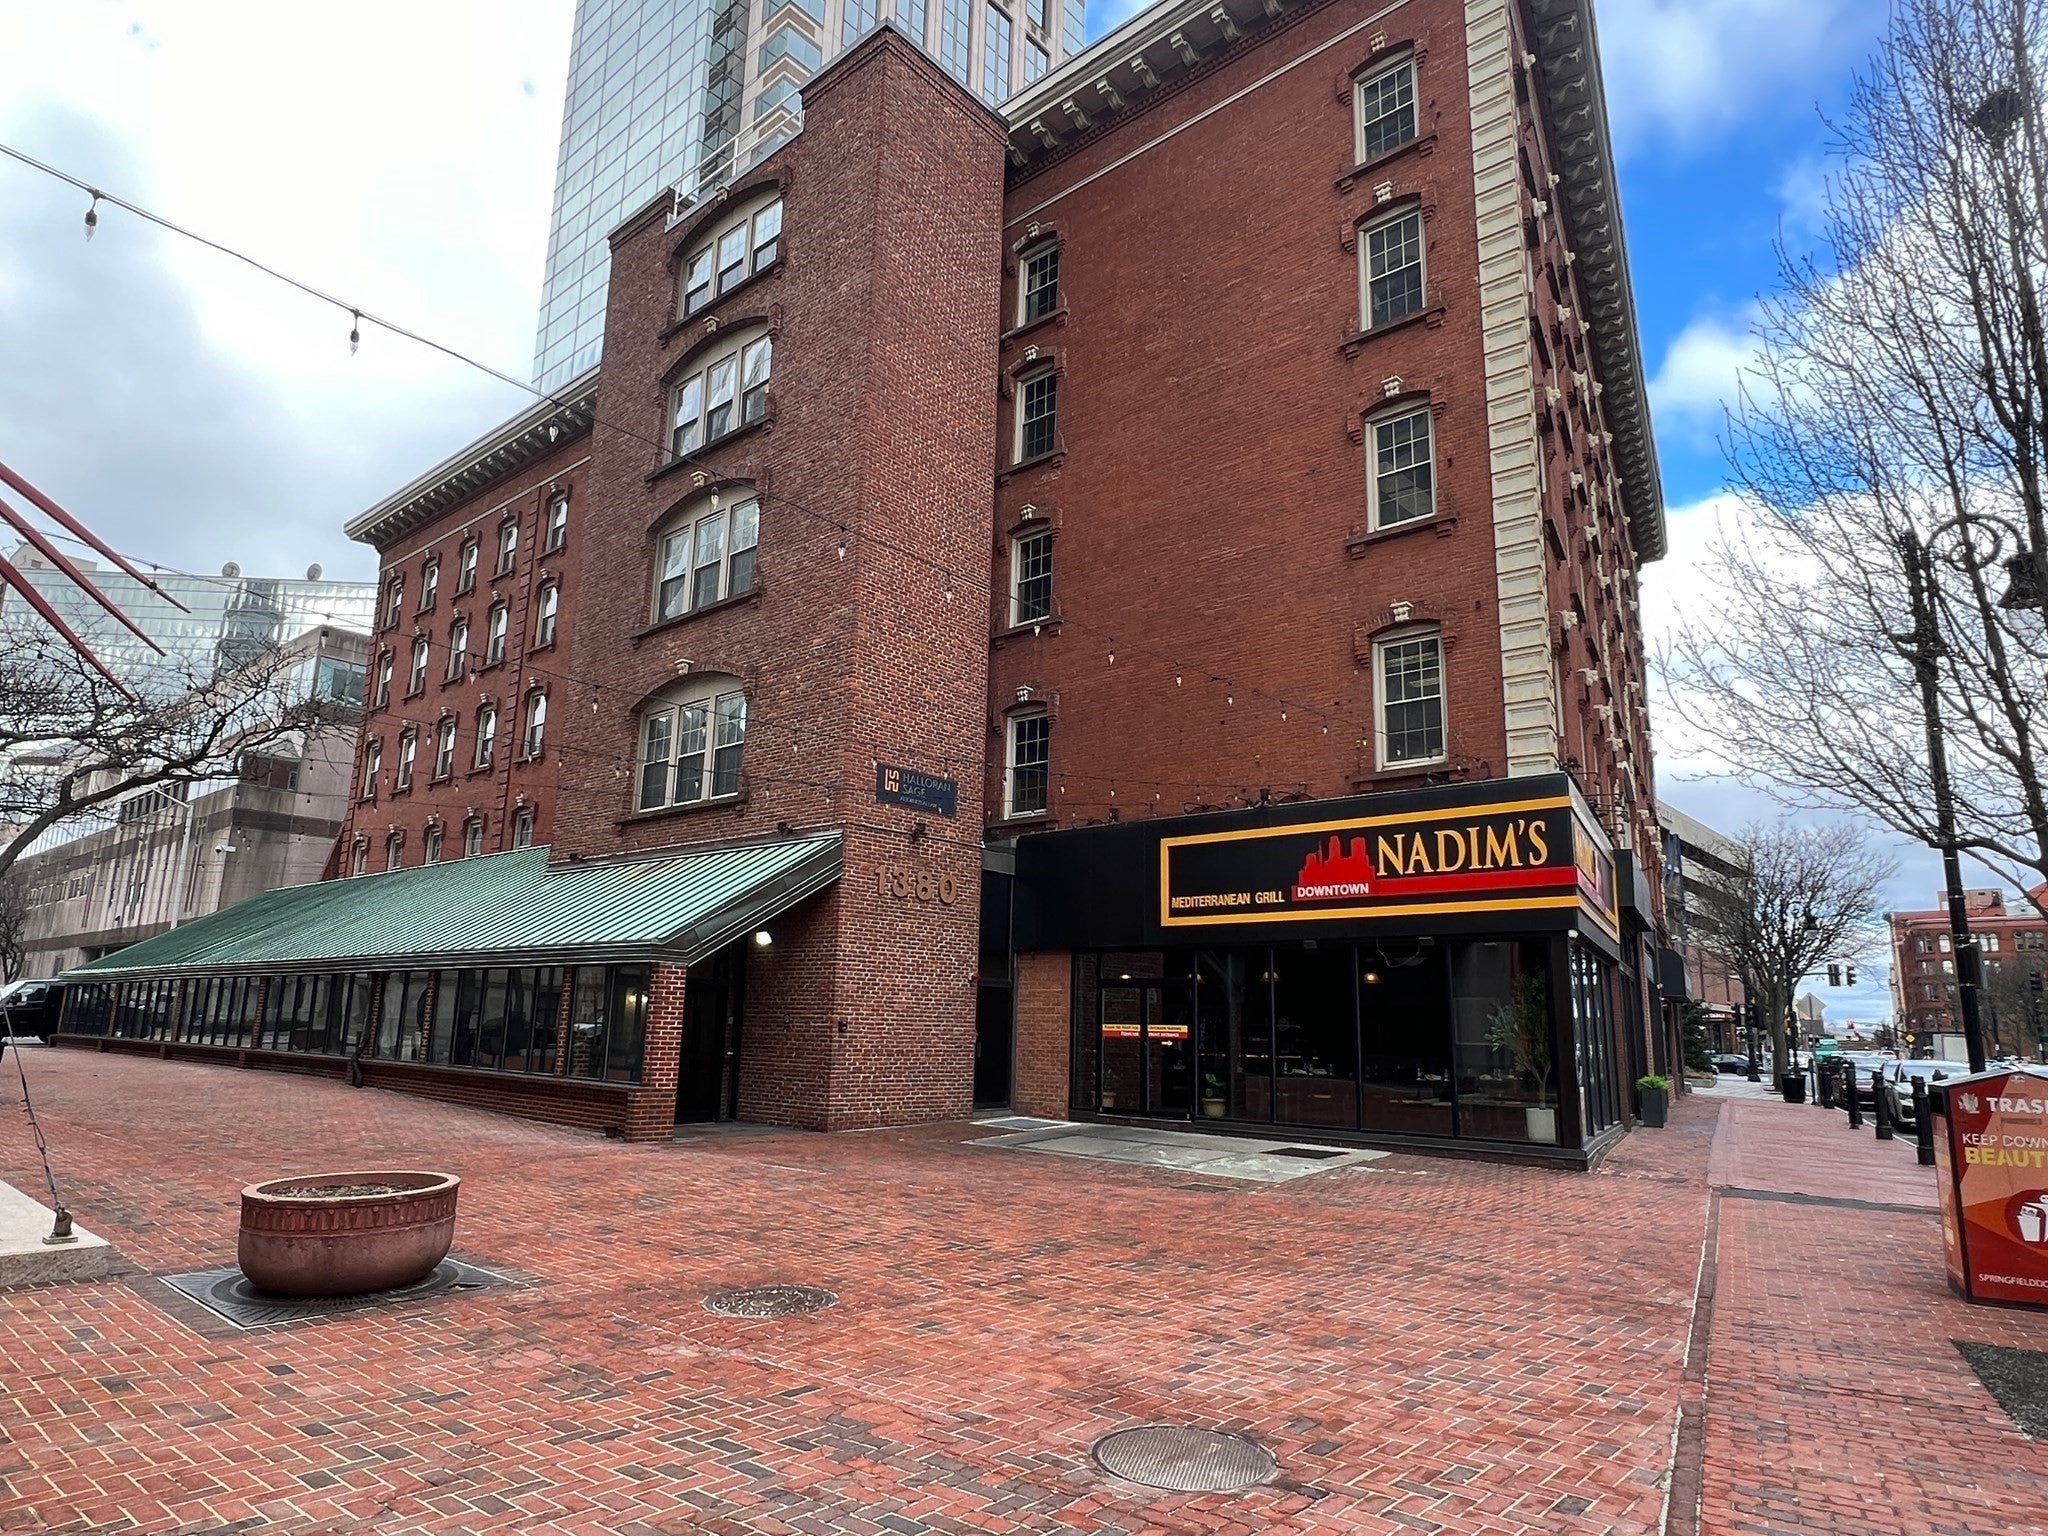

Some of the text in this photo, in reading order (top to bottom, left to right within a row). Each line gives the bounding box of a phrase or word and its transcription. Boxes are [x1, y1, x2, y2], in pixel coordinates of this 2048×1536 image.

[902, 772, 951, 792] HALLORAN
[902, 784, 927, 798] SAGE
[1376, 819, 1548, 876] NADIM'S
[874, 865, 957, 904] 1380
[1297, 883, 1369, 898] DOWNTOWN
[1171, 891, 1285, 908] MEDITERRANEAN GRILL
[1986, 1097, 2048, 1114] TRAS
[1962, 1133, 1998, 1146] KEEP
[1964, 1147, 2048, 1169] BEAUT
